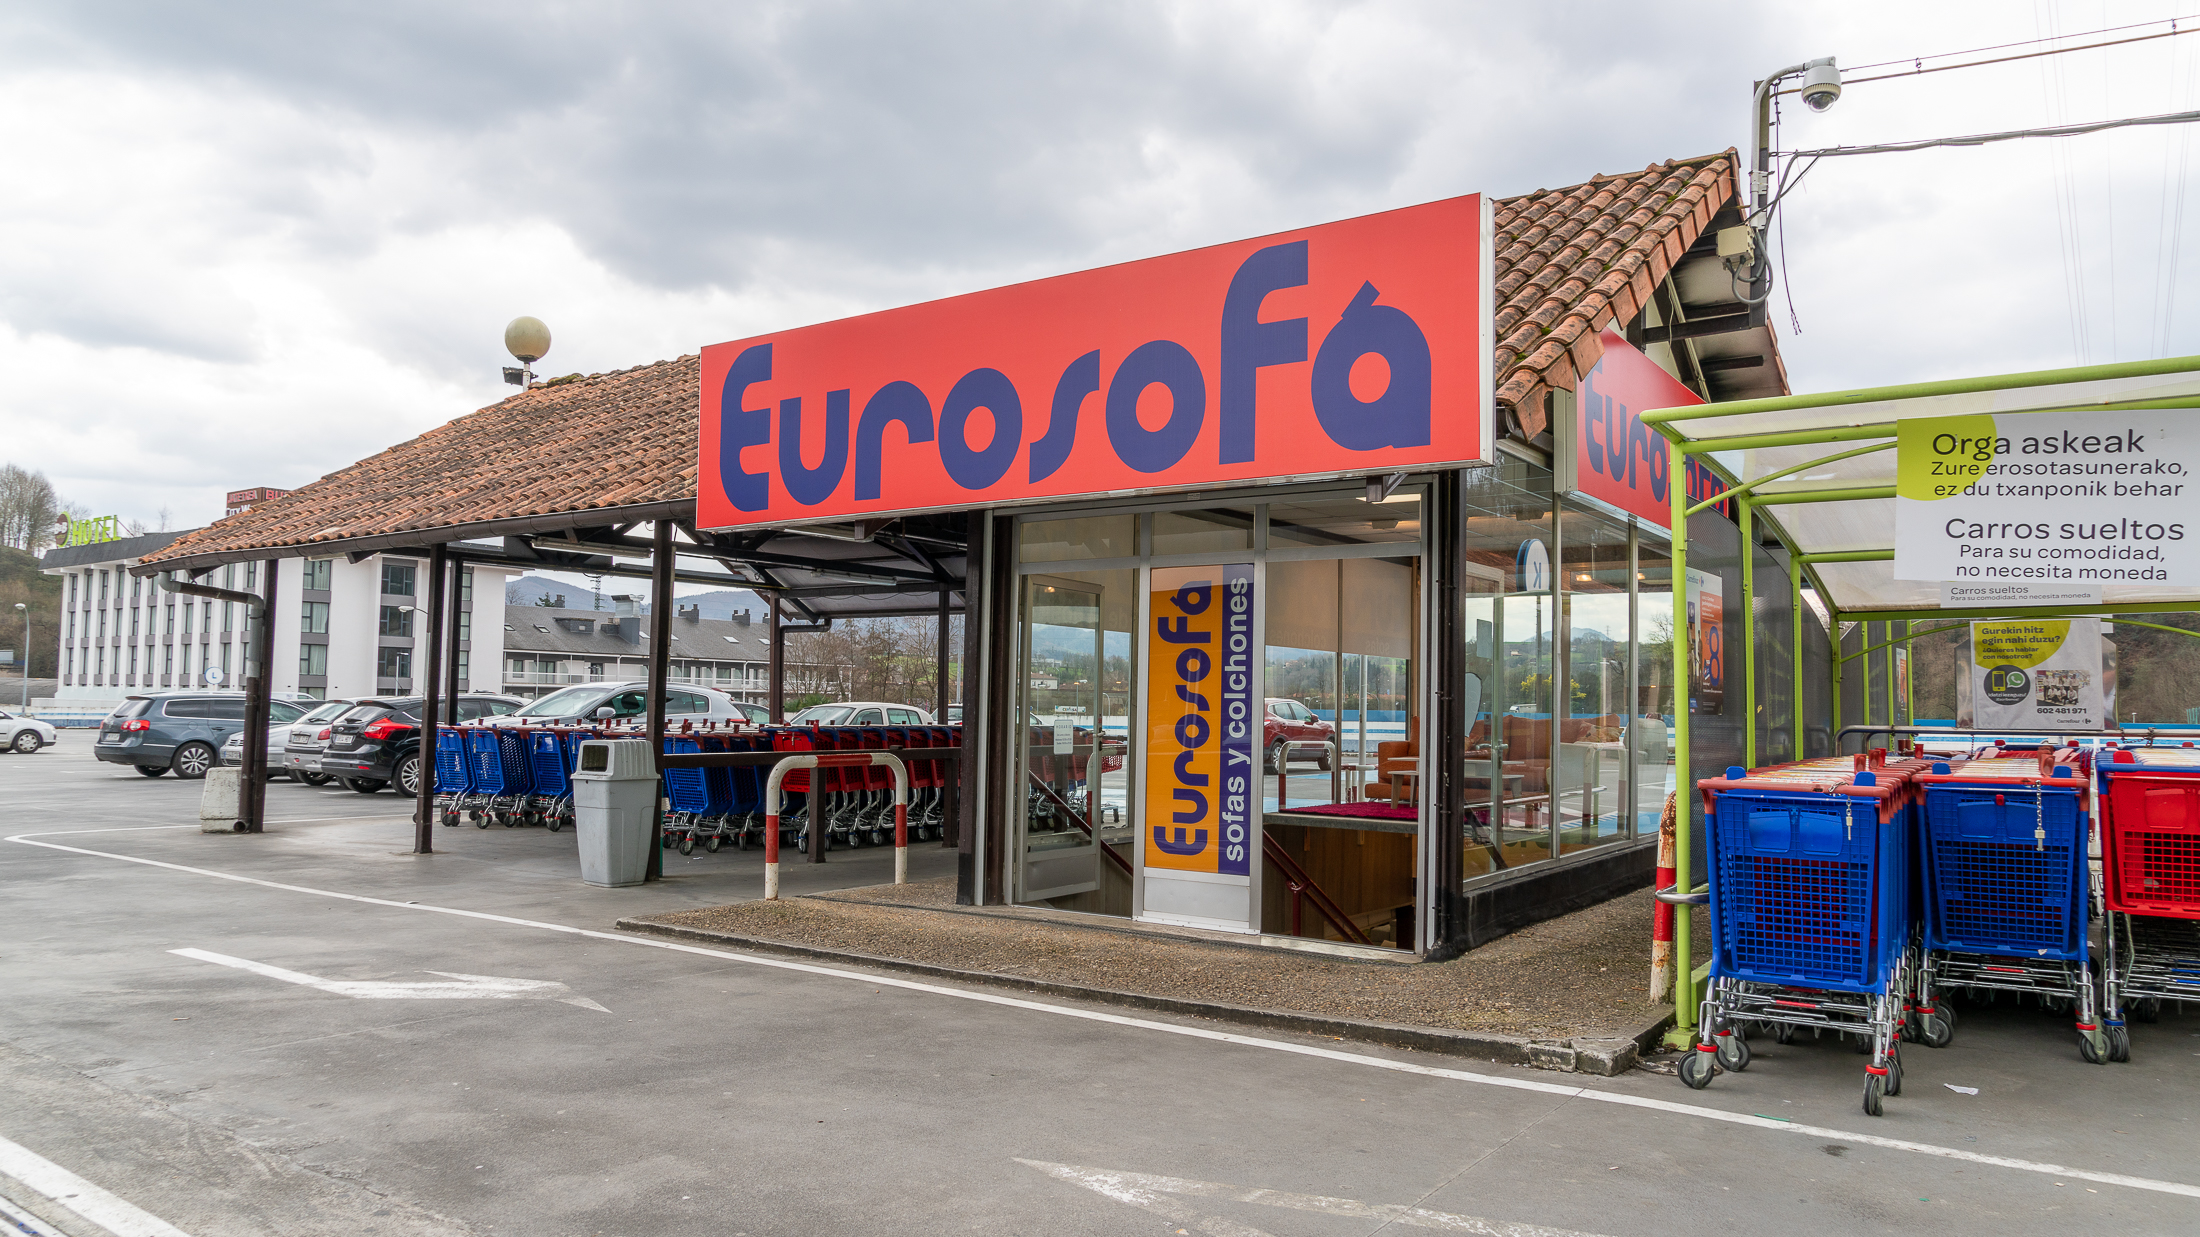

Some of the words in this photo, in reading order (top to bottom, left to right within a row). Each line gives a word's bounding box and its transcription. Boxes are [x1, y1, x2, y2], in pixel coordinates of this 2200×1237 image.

[1932, 432, 2011, 461] Orga
[2021, 428, 2145, 454] askeak
[1931, 461, 1980, 476] Zure
[1985, 459, 2188, 477] erosotasunerako,
[1934, 483, 1958, 497] ez
[1963, 481, 1990, 496] du
[1996, 481, 2108, 500] txanponik
[2113, 480, 2184, 496] behar
[72, 515, 122, 546] HOTEL
[1945, 517, 2051, 539] Carros
[2059, 517, 2185, 541] sueltos
[1959, 544, 2004, 558] Para
[2009, 547, 2032, 558] su
[2037, 545, 2166, 562] comodidad,
[1956, 566, 1980, 577] no
[1985, 564, 2073, 579] necesita
[2078, 565, 2168, 581] moneda
[1950, 587, 1987, 595] Carros
[1988, 586, 2029, 594] sueltos
[1981, 626, 2022, 635] Gurekin
[2024, 626, 2045, 634] hitz
[1981, 636, 2004, 646] egin
[2005, 635, 2027, 643] nahi
[2029, 635, 2061, 643] duzu?
[1223, 577, 1248, 739] colchones
[1228, 748, 1251, 766] y
[1222, 776, 1246, 862] sofas
